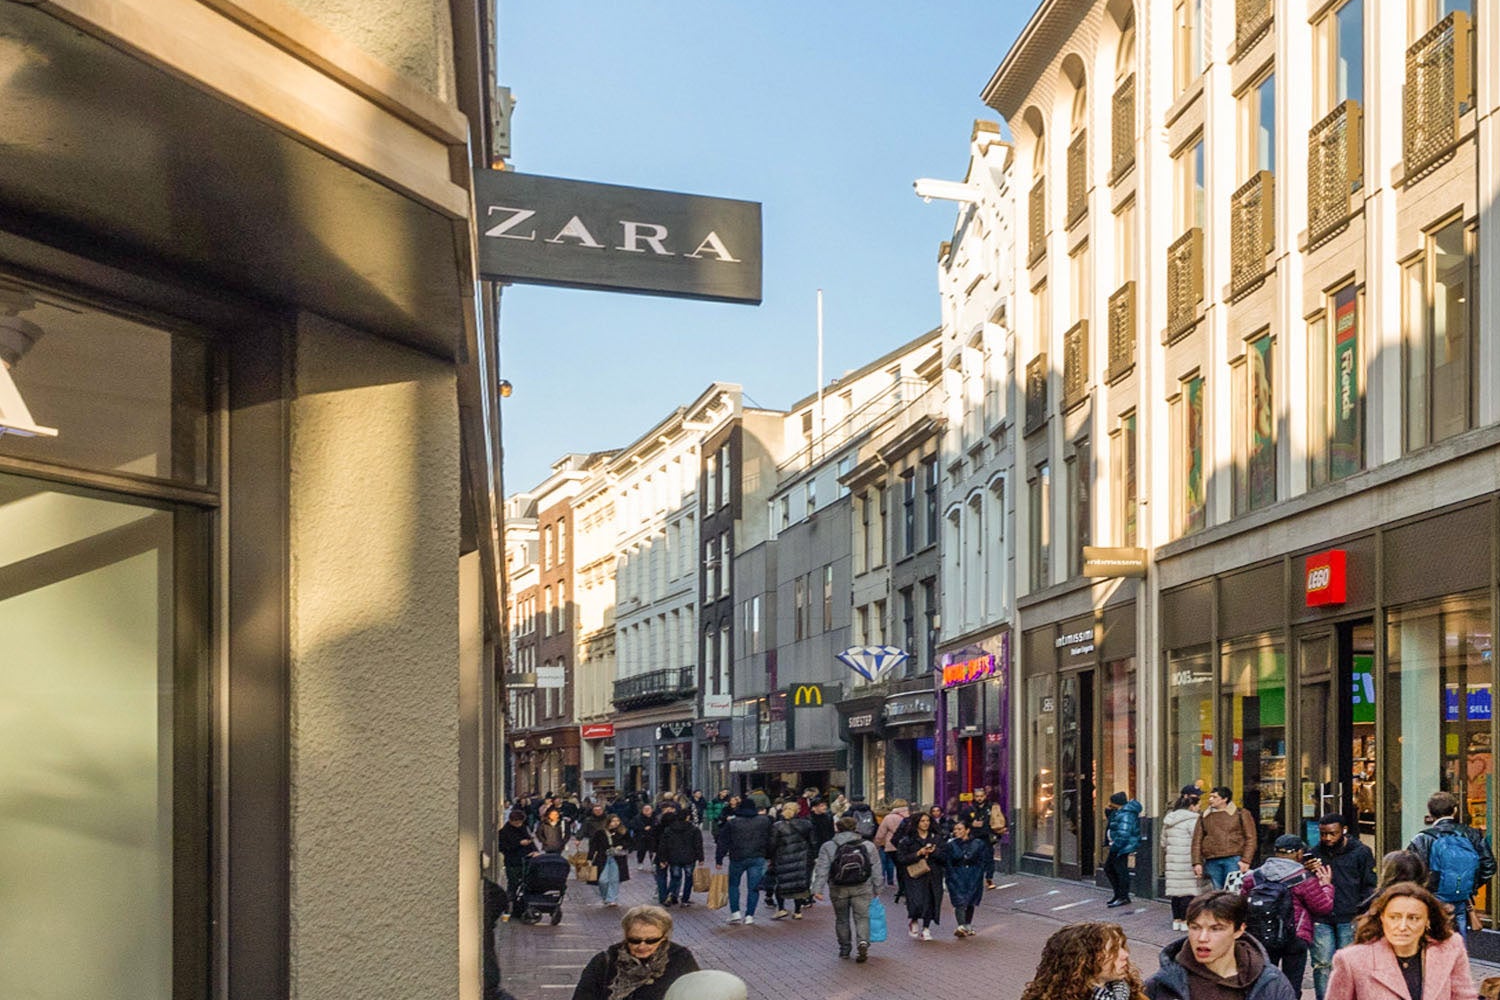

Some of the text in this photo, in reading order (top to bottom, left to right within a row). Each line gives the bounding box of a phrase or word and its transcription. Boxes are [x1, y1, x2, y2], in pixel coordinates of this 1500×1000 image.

[485, 206, 741, 263] ZARA
[1308, 567, 1330, 590] LEGO
[1469, 705, 1490, 713] SELL
